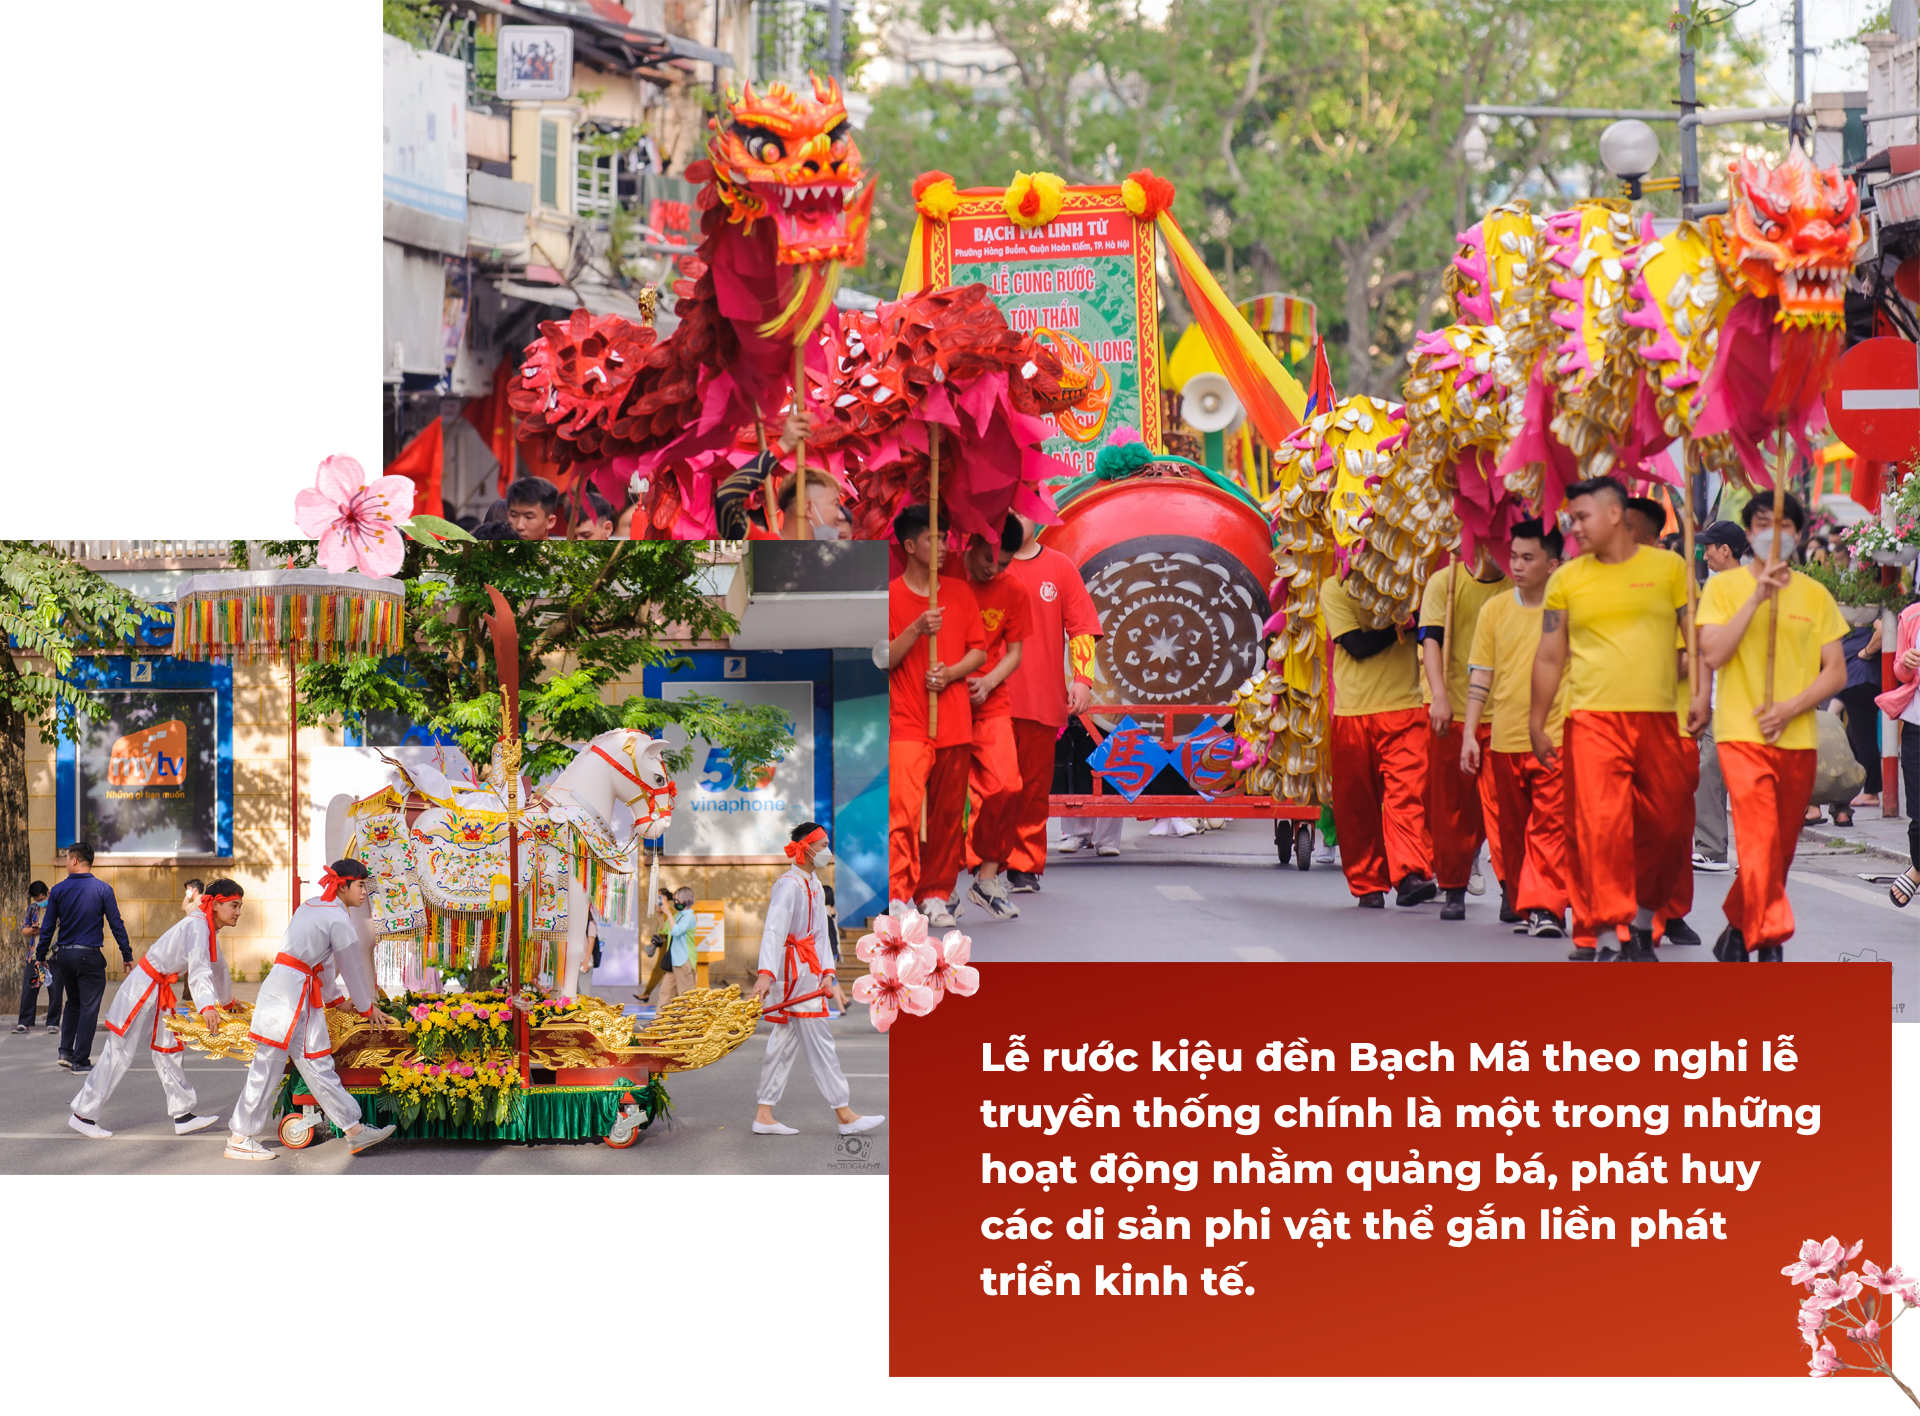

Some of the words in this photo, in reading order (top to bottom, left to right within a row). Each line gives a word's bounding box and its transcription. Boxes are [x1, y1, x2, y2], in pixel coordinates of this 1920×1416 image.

[974, 226, 1015, 244] BẠCH
[1048, 222, 1084, 238] LINH
[1087, 217, 1109, 236] TỪ
[955, 248, 982, 258] Phường
[984, 246, 1003, 257] Hàng
[1051, 242, 1071, 252] Hoàn
[1072, 240, 1093, 252] Kiếm,
[1094, 241, 1104, 250] TP.
[1105, 240, 1116, 249] Hà
[1117, 239, 1130, 250] Nội
[992, 265, 1009, 295] LỄ
[1013, 271, 1053, 294] CUNG
[1056, 264, 1096, 292] RƯỚC
[1010, 305, 1038, 331] TÔN
[1094, 339, 1132, 362] LONG
[112, 750, 184, 784] mytv
[1091, 728, 1154, 792] 馬
[106, 791, 133, 800] Những
[145, 791, 160, 800] bạn
[162, 790, 185, 799] muốn
[691, 796, 785, 814] vinaphone
